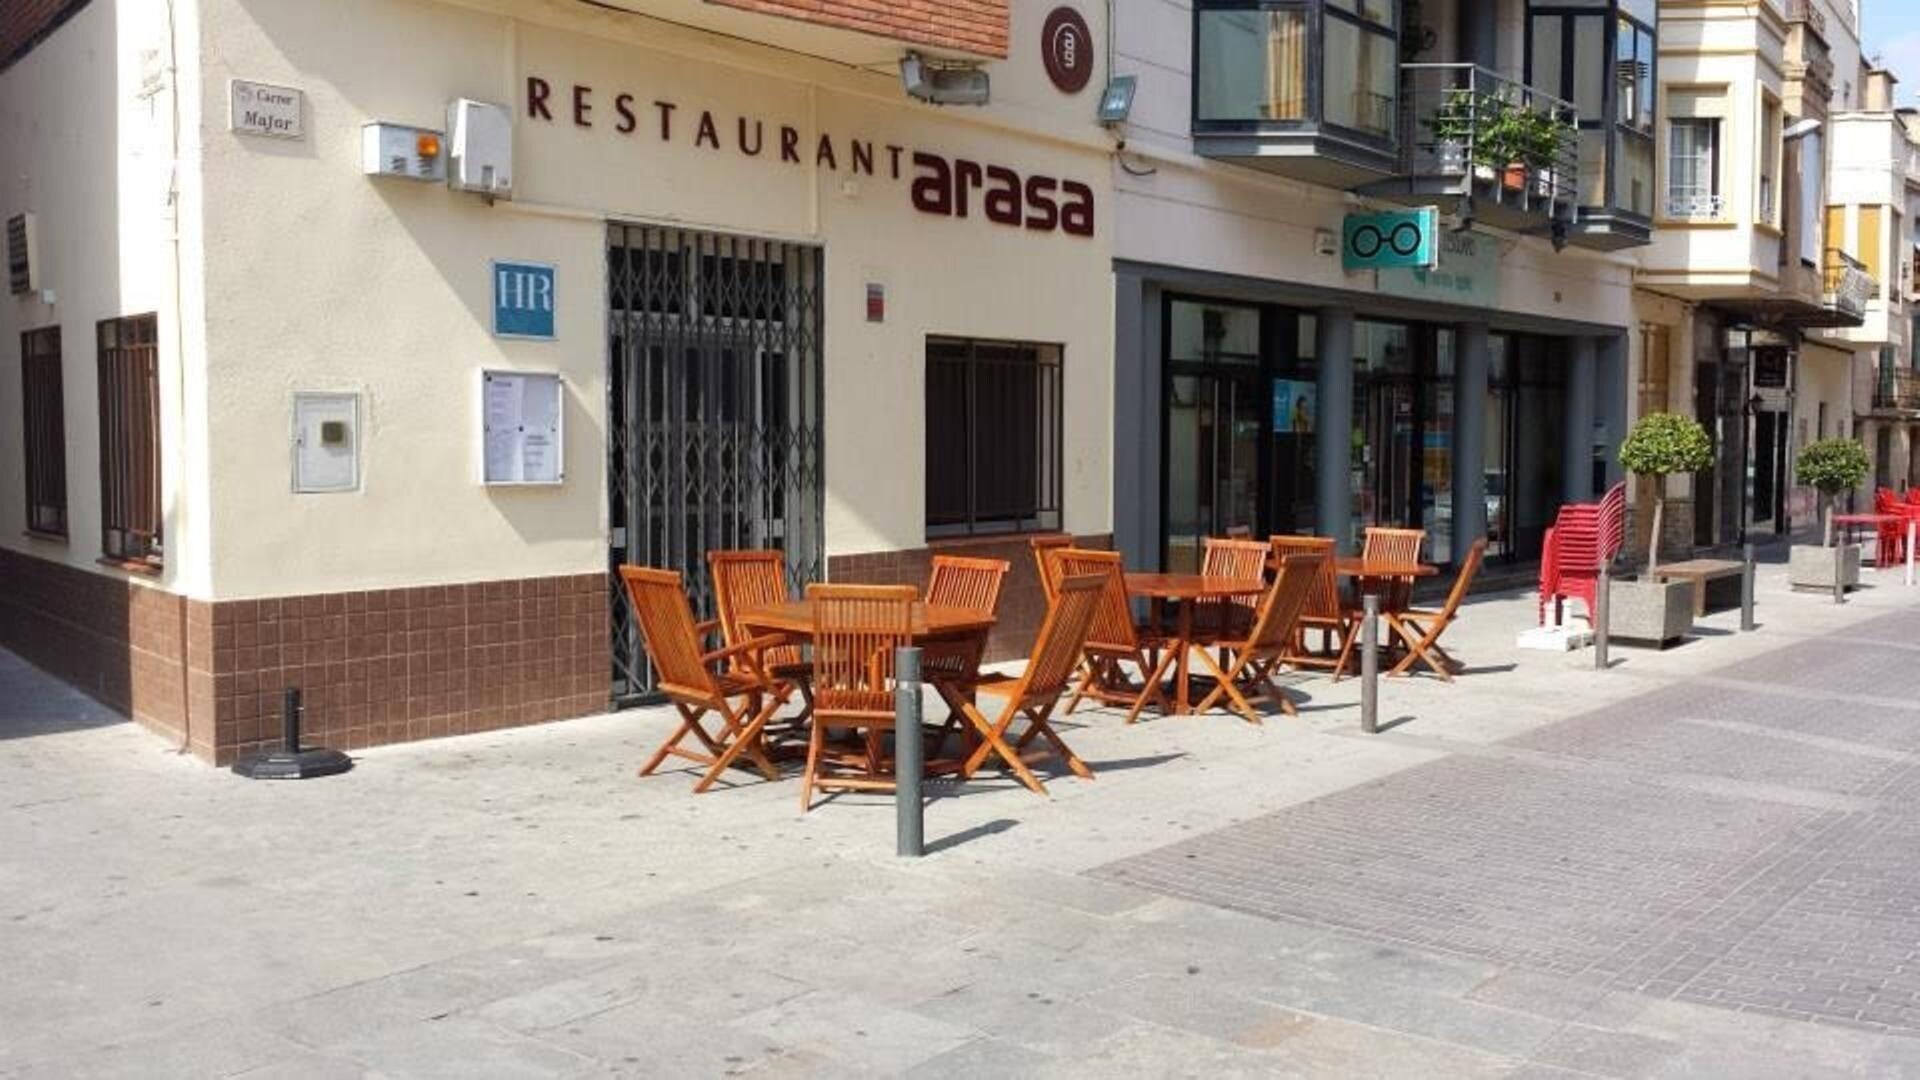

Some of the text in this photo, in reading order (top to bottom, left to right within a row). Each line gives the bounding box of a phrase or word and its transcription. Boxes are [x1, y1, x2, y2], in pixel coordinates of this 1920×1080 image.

[244, 111, 292, 130] Major
[526, 76, 1094, 237] RESTAURANT arasa
[499, 271, 551, 311] HR
